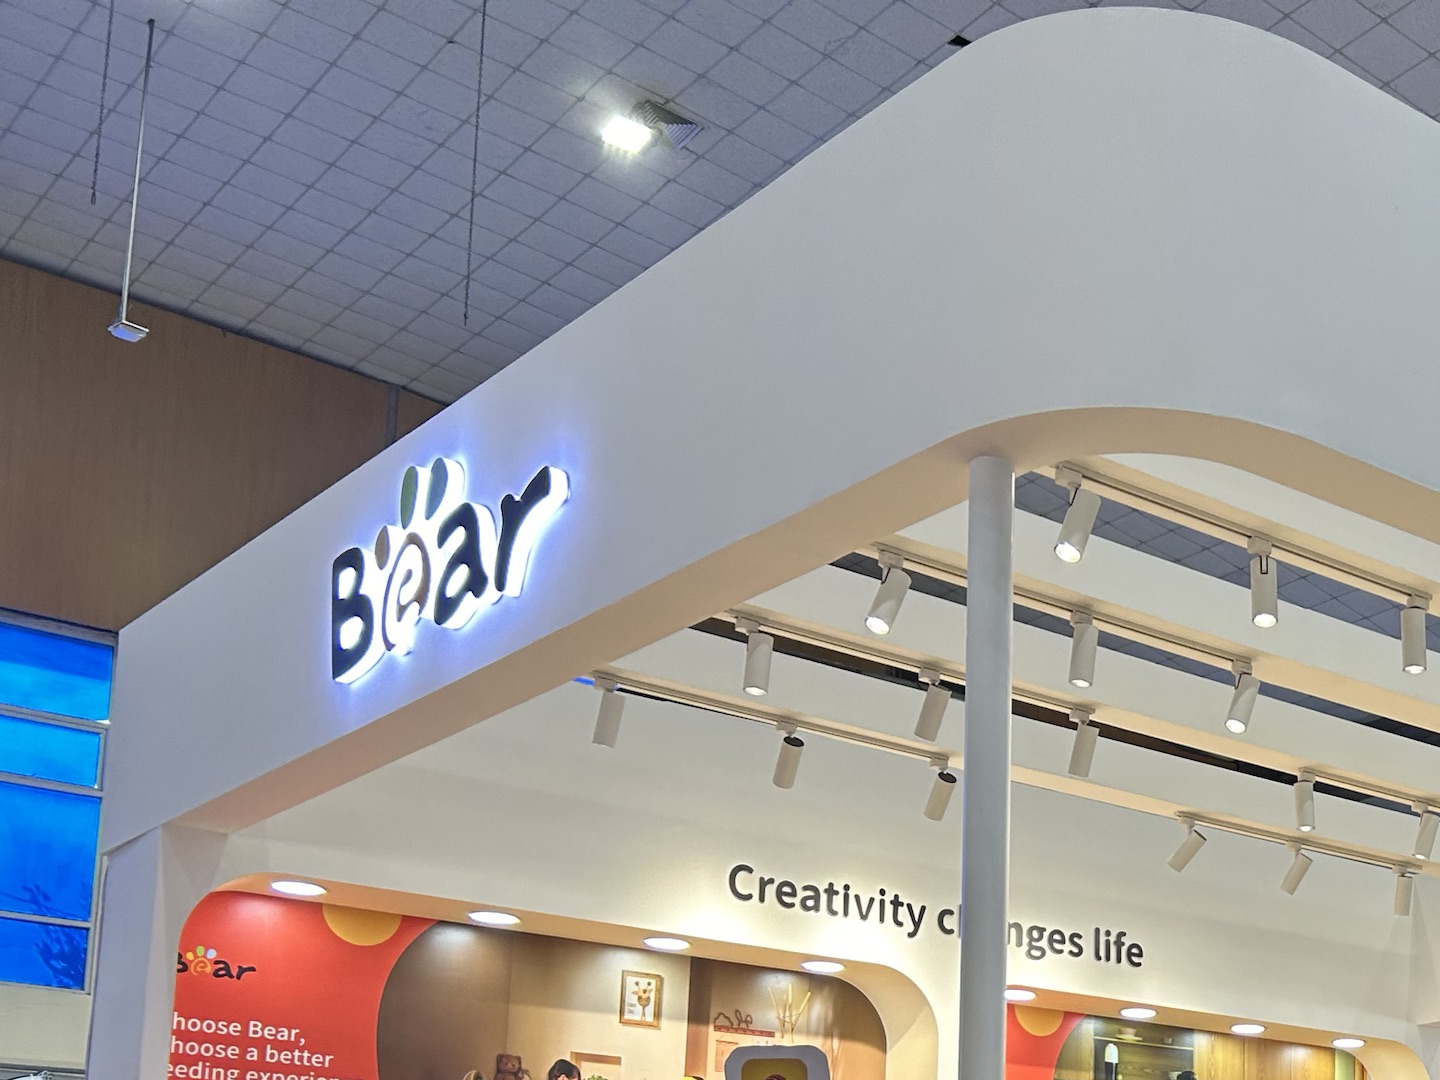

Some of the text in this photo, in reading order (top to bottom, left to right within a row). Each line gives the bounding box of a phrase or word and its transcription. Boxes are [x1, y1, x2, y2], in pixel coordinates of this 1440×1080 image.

[332, 458, 569, 684] Bear
[729, 863, 1144, 968] Creativity cnges life
[170, 1036, 334, 1068] hoose a better
[172, 1012, 306, 1046] hoose Bear,
